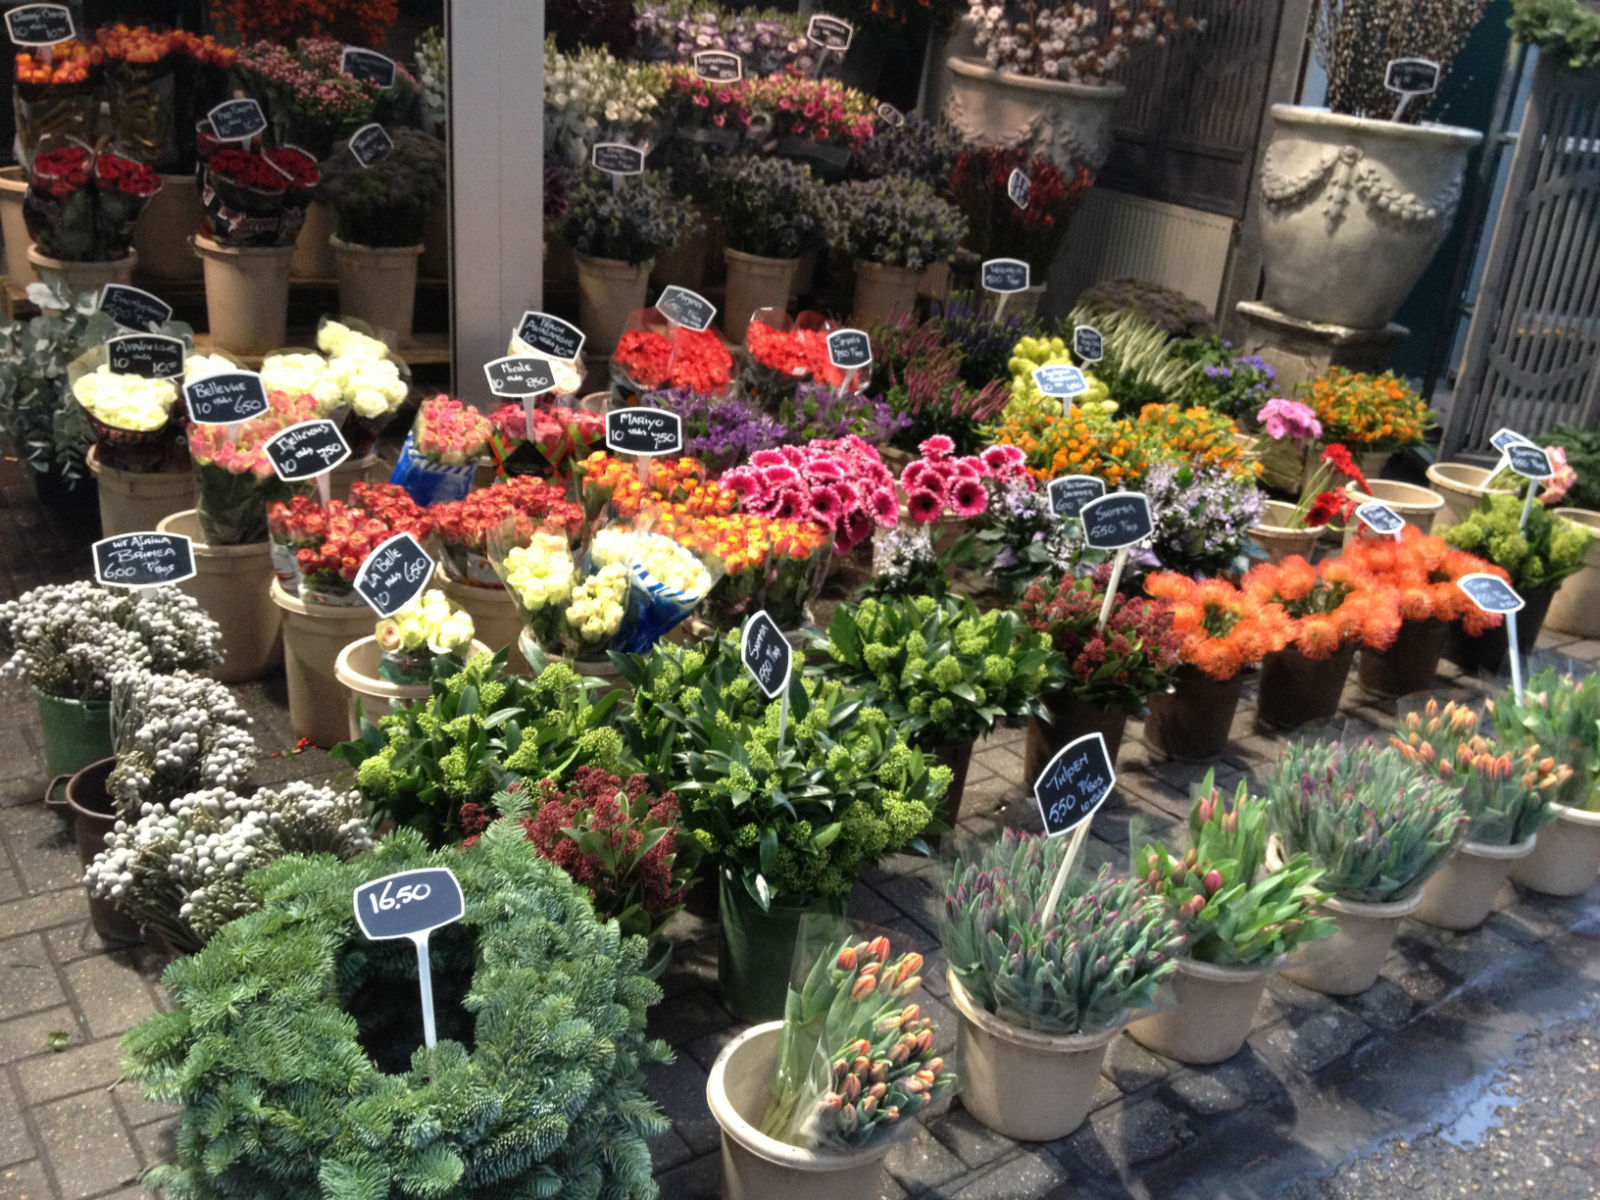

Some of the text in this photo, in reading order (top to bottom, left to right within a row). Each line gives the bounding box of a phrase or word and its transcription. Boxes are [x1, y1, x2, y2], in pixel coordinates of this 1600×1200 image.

[113, 357, 130, 370] 10
[492, 378, 505, 392] 10
[195, 401, 213, 415] 10
[611, 428, 625, 442] 10
[280, 458, 298, 474] 10
[373, 591, 391, 610] 10
